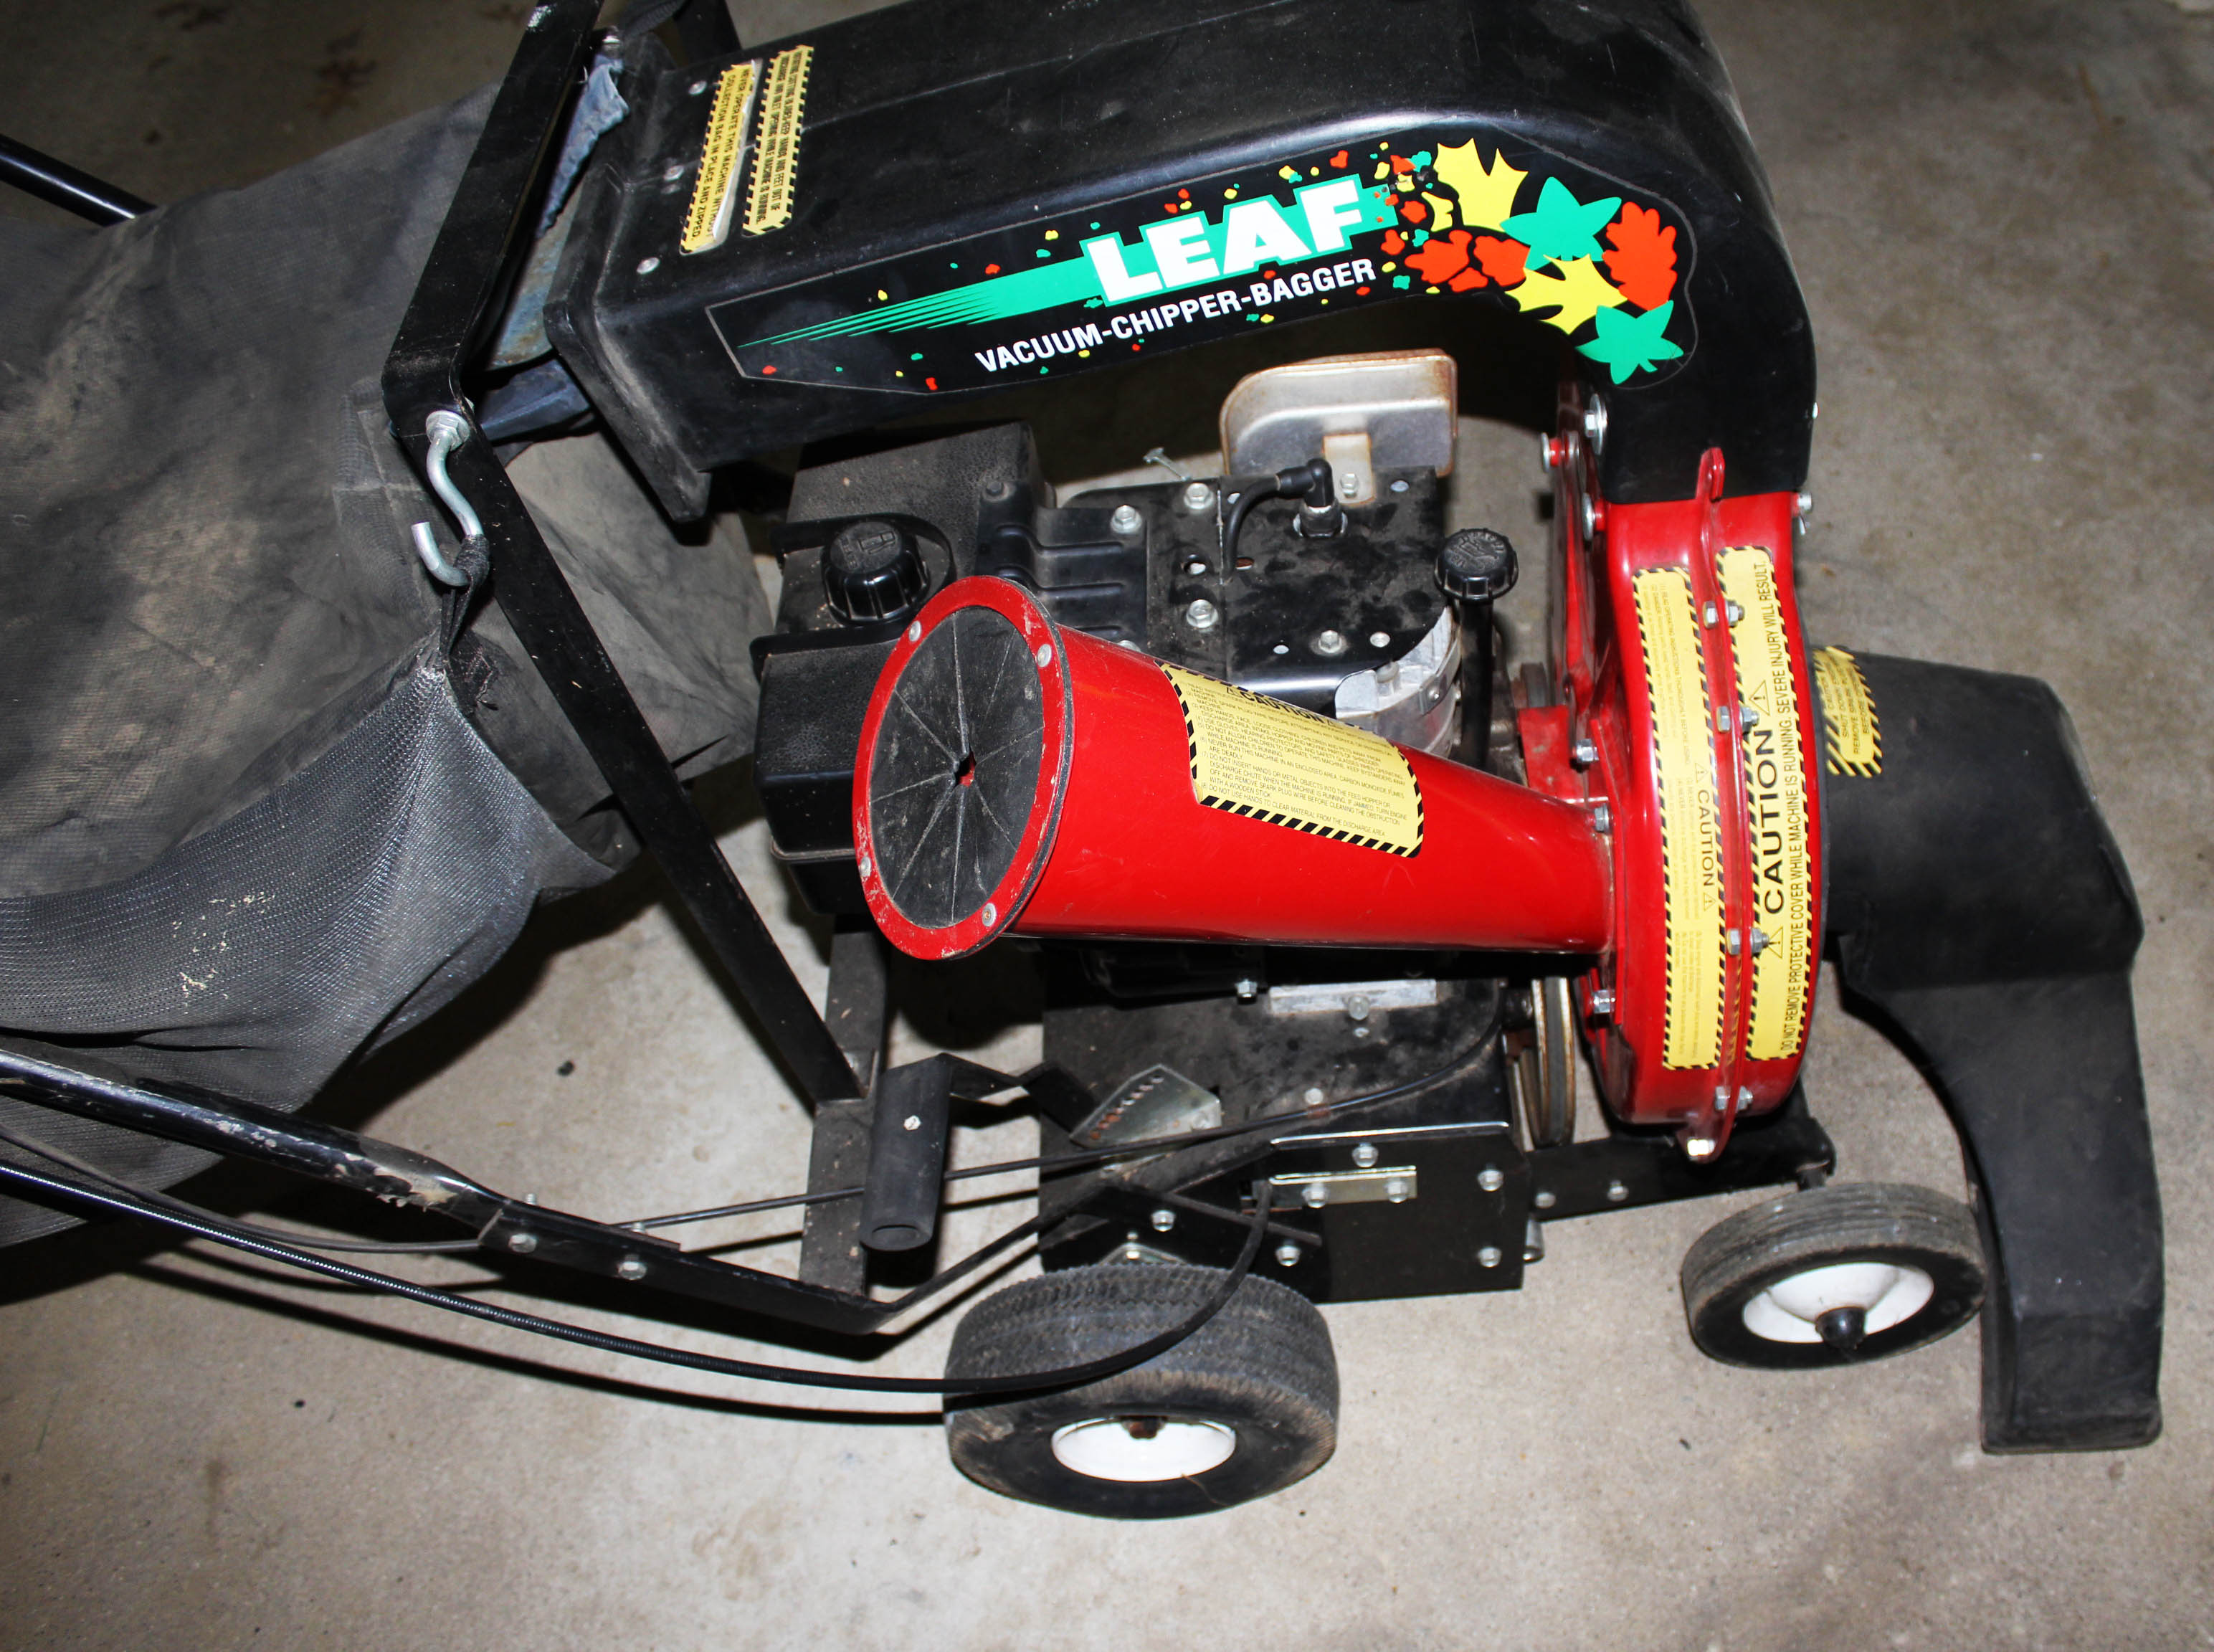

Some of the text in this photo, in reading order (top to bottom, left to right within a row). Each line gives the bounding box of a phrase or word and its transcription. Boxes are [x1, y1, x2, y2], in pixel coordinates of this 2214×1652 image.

[690, 74, 736, 241] COLLECTION BAG IN PLACE AND ZIPPED.
[723, 130, 736, 153] THIS
[714, 153, 731, 194] MACHINE
[1086, 179, 1364, 303] LEAF
[974, 257, 1377, 373] VACUUM-CHIPPER-BAGGER
[1240, 691, 1325, 723] CAUTION
[1858, 700, 1870, 734] BEFORE
[1206, 731, 1225, 741] WHILE
[1225, 736, 1250, 749] MACHINE
[1227, 730, 1246, 741] ALLOW
[1247, 735, 1275, 749] CHILDREN
[1283, 746, 1308, 758] OPERATE
[1850, 716, 1860, 754] REMOVE
[1207, 737, 1227, 749] NEVER
[1241, 746, 1254, 756] THIS
[1255, 750, 1279, 764] MACHINE
[1295, 761, 1322, 776] ENCLOSED
[1210, 759, 1242, 775] DISCHARGE
[1243, 769, 1262, 781] CHUTE
[1263, 774, 1279, 785] WHEN
[1291, 782, 1315, 795] MACHINE
[1209, 776, 1224, 786] WITH
[1229, 781, 1254, 794] WOODEN
[1232, 758, 1251, 770] INSERT
[1253, 764, 1271, 776] HANDS
[1281, 772, 1298, 783] METAL
[1299, 777, 1323, 789] OBJECTS
[1324, 784, 1336, 793] INTO
[1347, 790, 1361, 800] FEED
[1362, 794, 1382, 806] HOPPER
[1235, 774, 1258, 787] REMOVE
[1258, 781, 1276, 792] SPARK
[1278, 786, 1292, 797] PLUG
[1293, 790, 1306, 800] WIRE
[1307, 794, 1329, 807] BEFORE
[1329, 800, 1354, 814] CLEANING
[1366, 810, 1400, 826] OBSTRUCTION
[1243, 792, 1263, 804] HANDS
[1272, 800, 1289, 812] CLEAR
[1290, 805, 1315, 818] MATERIAL
[1316, 812, 1331, 822] FROM
[1343, 820, 1371, 834] DISCHARGE
[1754, 561, 1804, 1050] DO NOT REMOVE PROTECTIVE COVER WHILE MACHINE IS RUNNING. SEVERE INJURY WILL RESULT.
[1754, 729, 1785, 914] CAUTION
[1698, 789, 1716, 886] CAUTION
